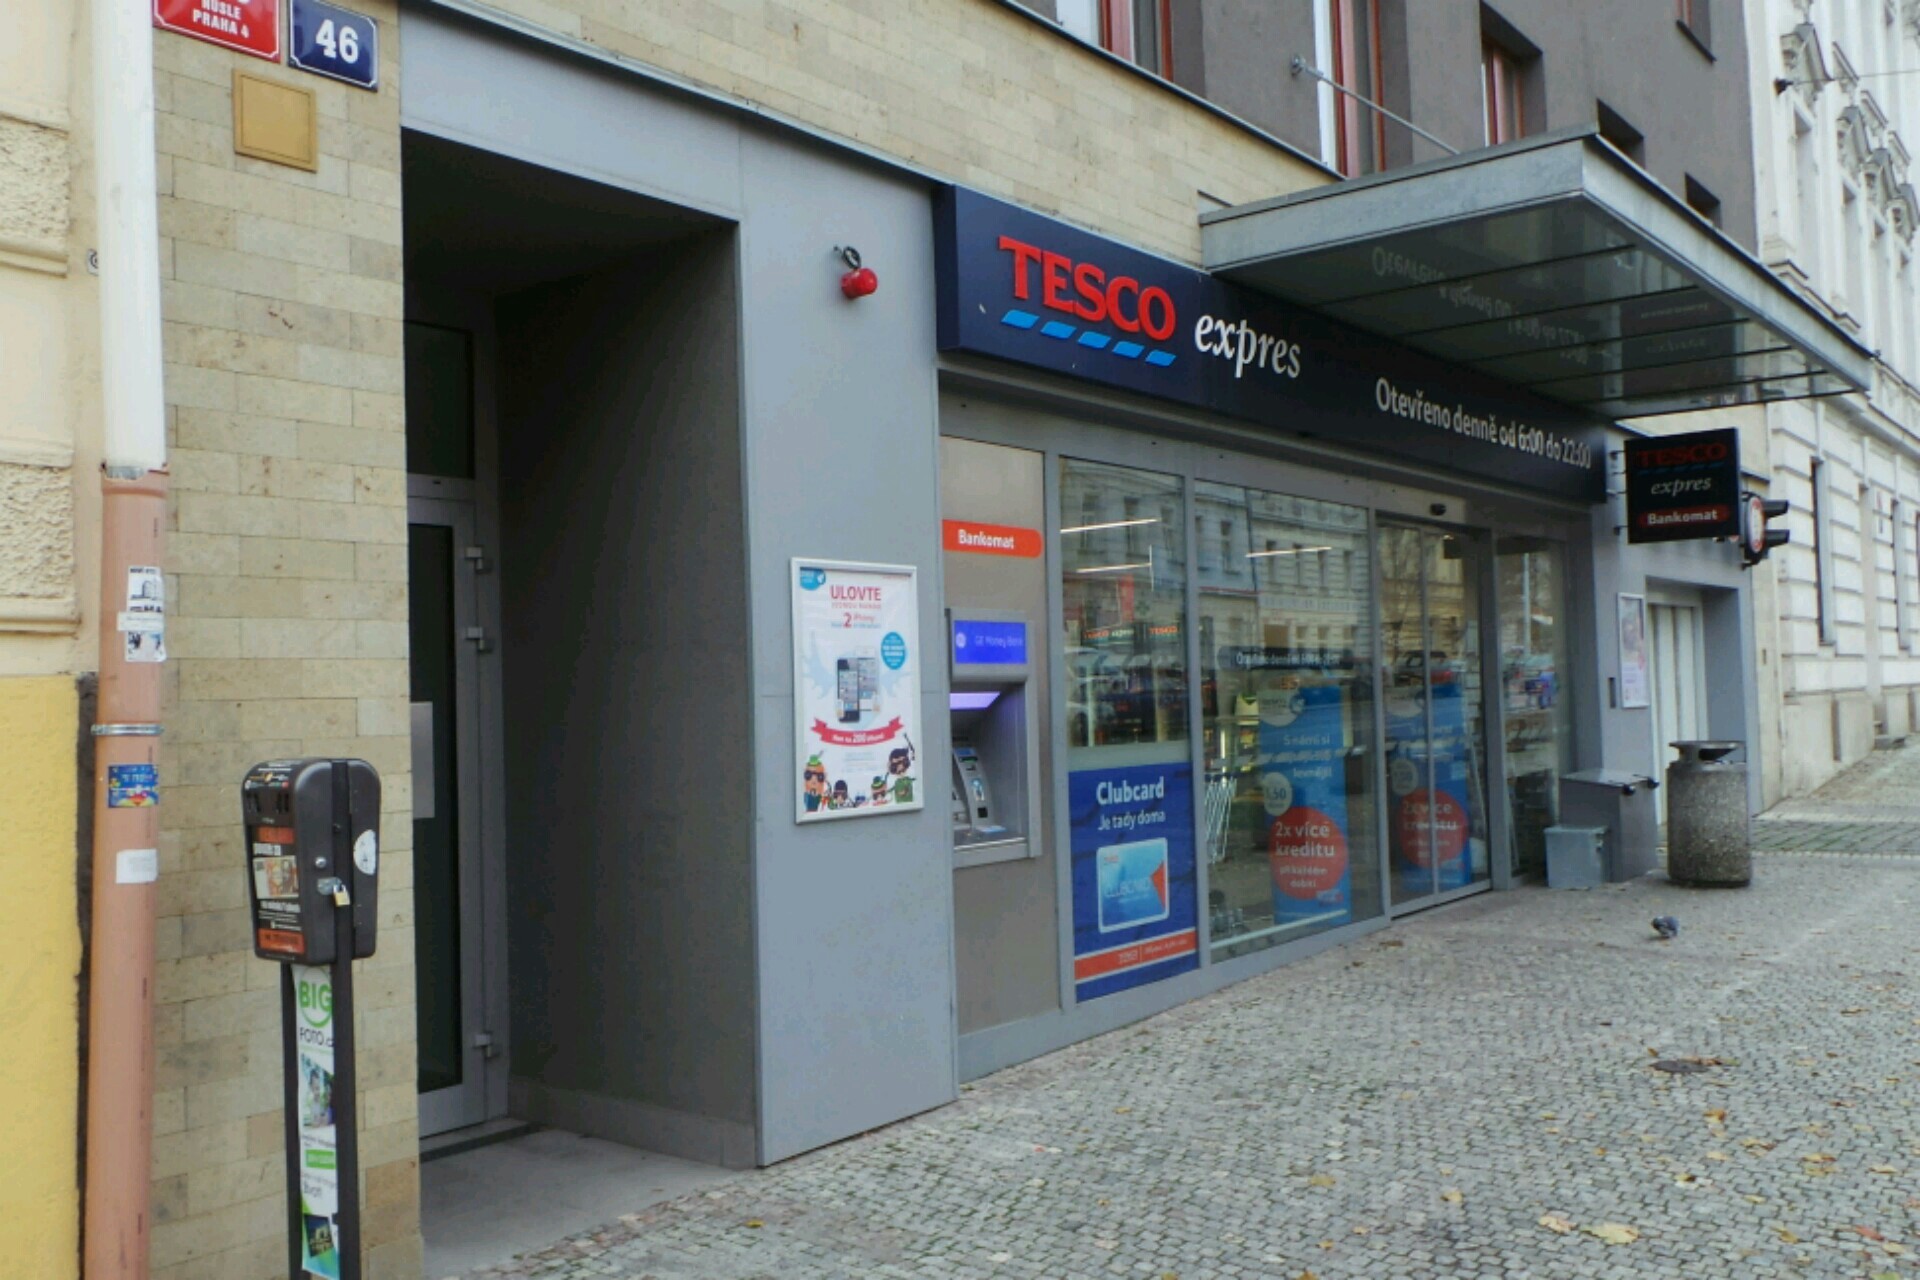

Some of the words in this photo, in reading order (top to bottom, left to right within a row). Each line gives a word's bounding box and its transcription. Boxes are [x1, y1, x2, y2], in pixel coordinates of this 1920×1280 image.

[192, 9, 238, 36] PRAHA
[240, 24, 250, 39] 4
[315, 19, 359, 64] 46
[998, 235, 1176, 341] TESCO
[1194, 314, 1300, 378] expres
[1375, 377, 1451, 429] Otevřeno
[1452, 404, 1498, 443] denně
[1499, 421, 1516, 449] od
[1518, 423, 1544, 456] 6:00
[1546, 432, 1561, 461] do
[1562, 437, 1592, 470] 22:00
[1636, 443, 1728, 468] TESCO
[1651, 477, 1712, 497] expres
[1647, 509, 1719, 526] Bankomat
[957, 528, 1015, 550] Bankomat
[830, 585, 882, 601] ULOVTE
[843, 612, 852, 628] 2
[1096, 776, 1165, 806] Clubcard
[1098, 816, 1111, 831] Je
[1112, 811, 1137, 830] tady
[1137, 809, 1166, 824] doma
[1275, 821, 1292, 837] 2x
[1295, 821, 1331, 838] více
[1275, 841, 1336, 858] kreditu
[299, 980, 333, 1013] BIG
